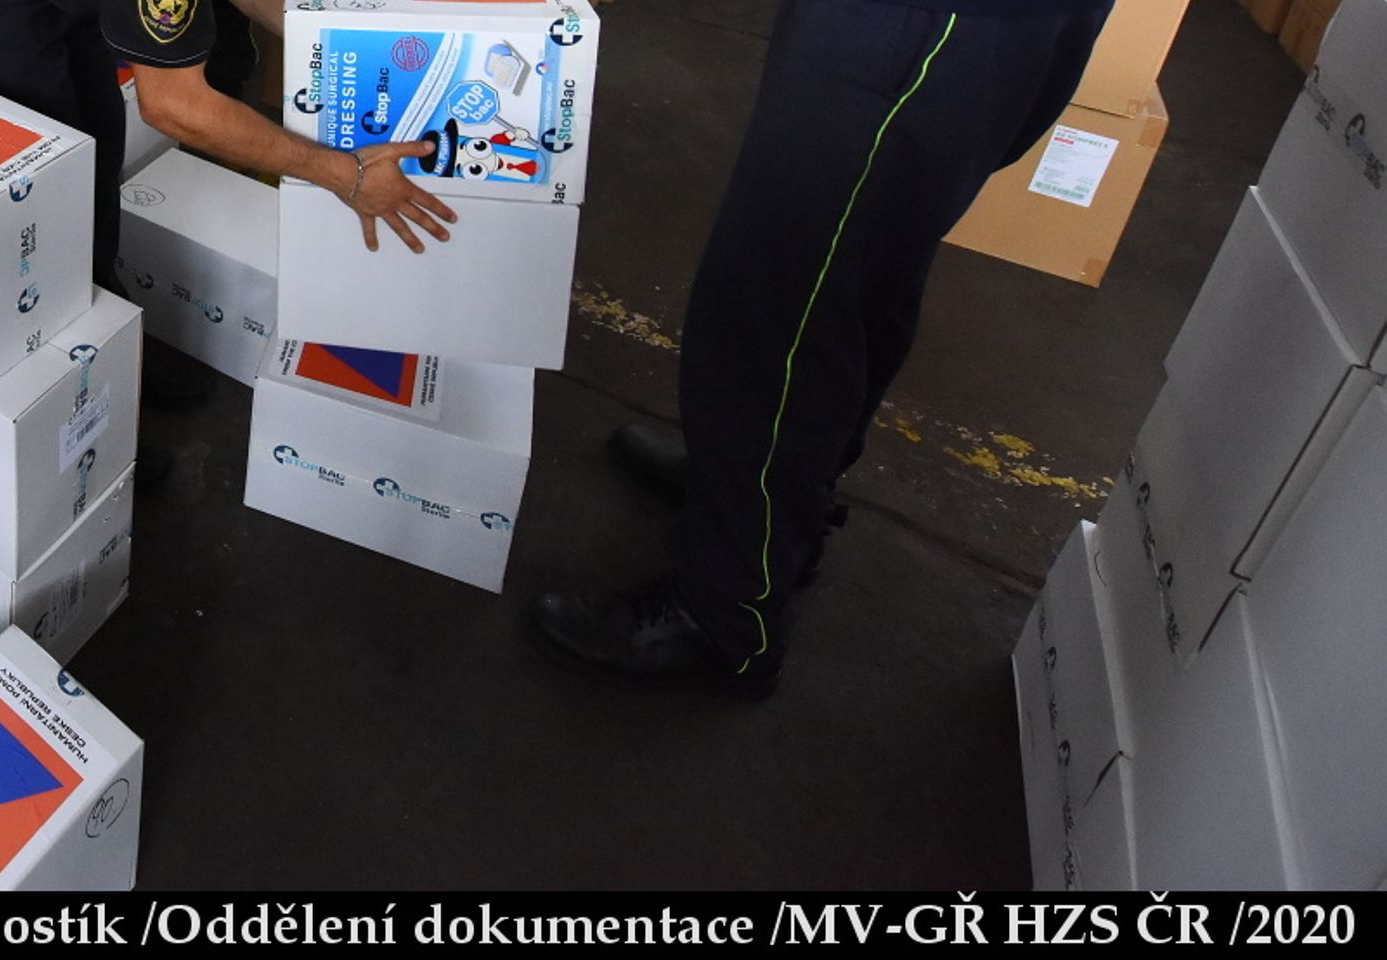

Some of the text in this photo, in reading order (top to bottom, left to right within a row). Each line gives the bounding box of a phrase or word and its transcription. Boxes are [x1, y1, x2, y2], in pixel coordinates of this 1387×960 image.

[309, 42, 325, 102] StopBac
[327, 51, 339, 105] SURGICAL
[374, 67, 391, 124] StopBac
[340, 51, 358, 149] DRESSING
[452, 84, 487, 120] STOP
[468, 98, 495, 122] bac
[557, 79, 576, 141] StopBac
[0, 667, 52, 716] REPUBLIKY
